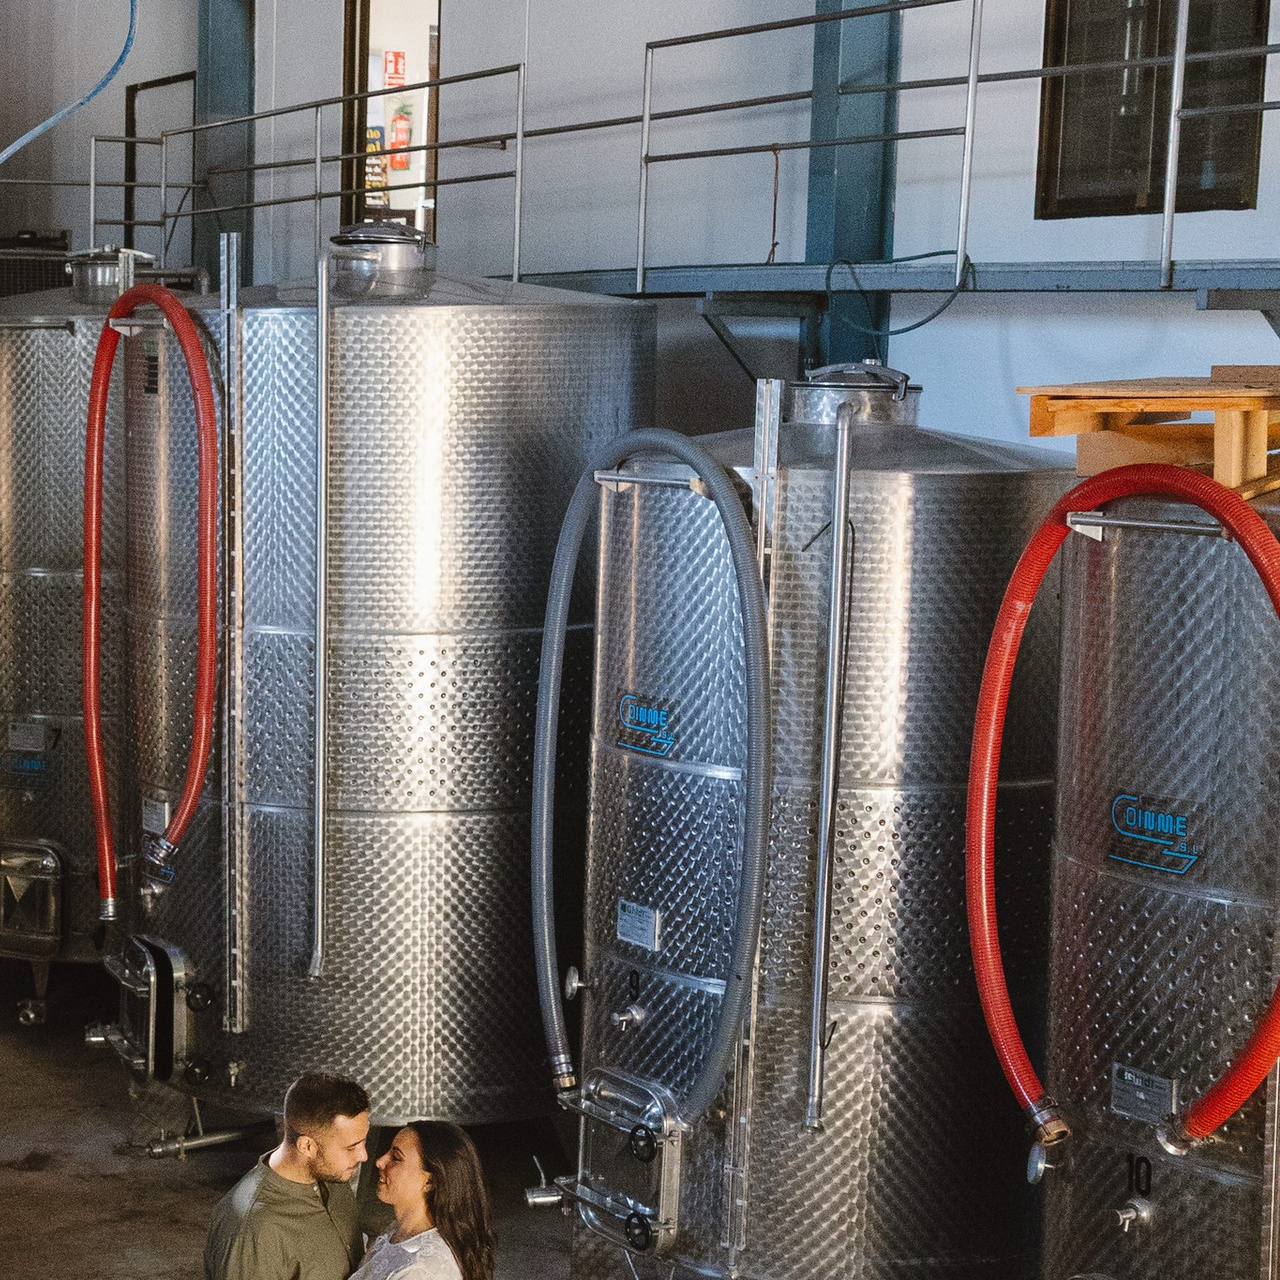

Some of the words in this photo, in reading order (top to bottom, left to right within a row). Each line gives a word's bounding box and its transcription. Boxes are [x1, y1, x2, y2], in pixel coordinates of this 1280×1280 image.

[620, 694, 667, 734] COINME
[1111, 794, 1187, 845] COINME
[630, 969, 640, 1001] 9
[1126, 1152, 1152, 1197] 10
